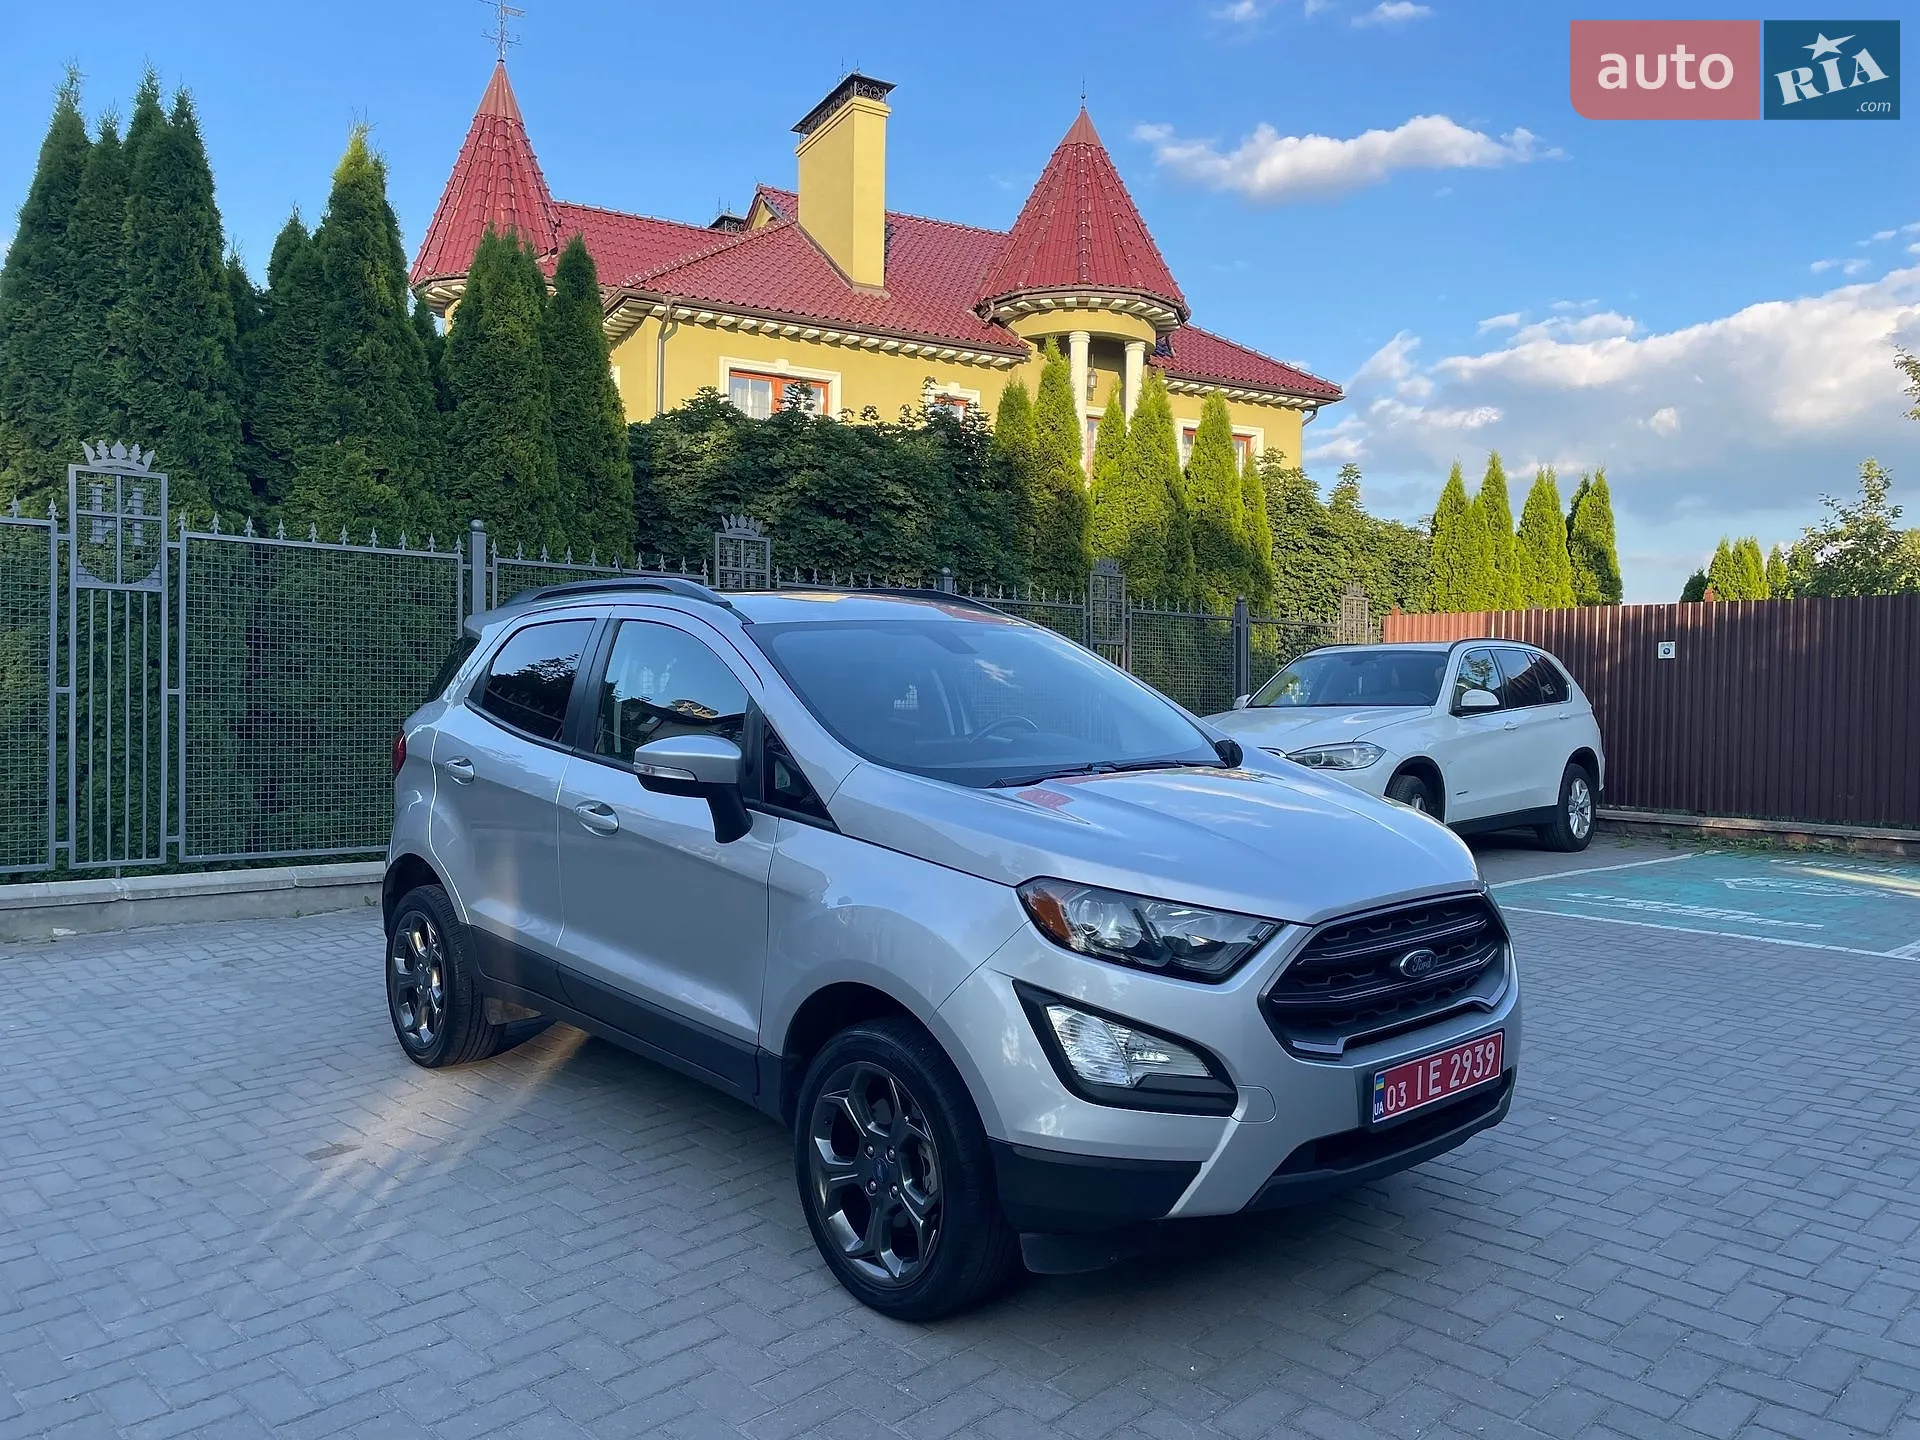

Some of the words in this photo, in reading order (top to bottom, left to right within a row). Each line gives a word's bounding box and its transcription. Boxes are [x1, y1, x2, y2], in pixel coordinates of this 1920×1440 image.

[1386, 1081, 1407, 1111] 03
[1417, 1059, 1442, 1100] IE
[1449, 1042, 1496, 1089] 2939
[1374, 1101, 1385, 1116] UA
